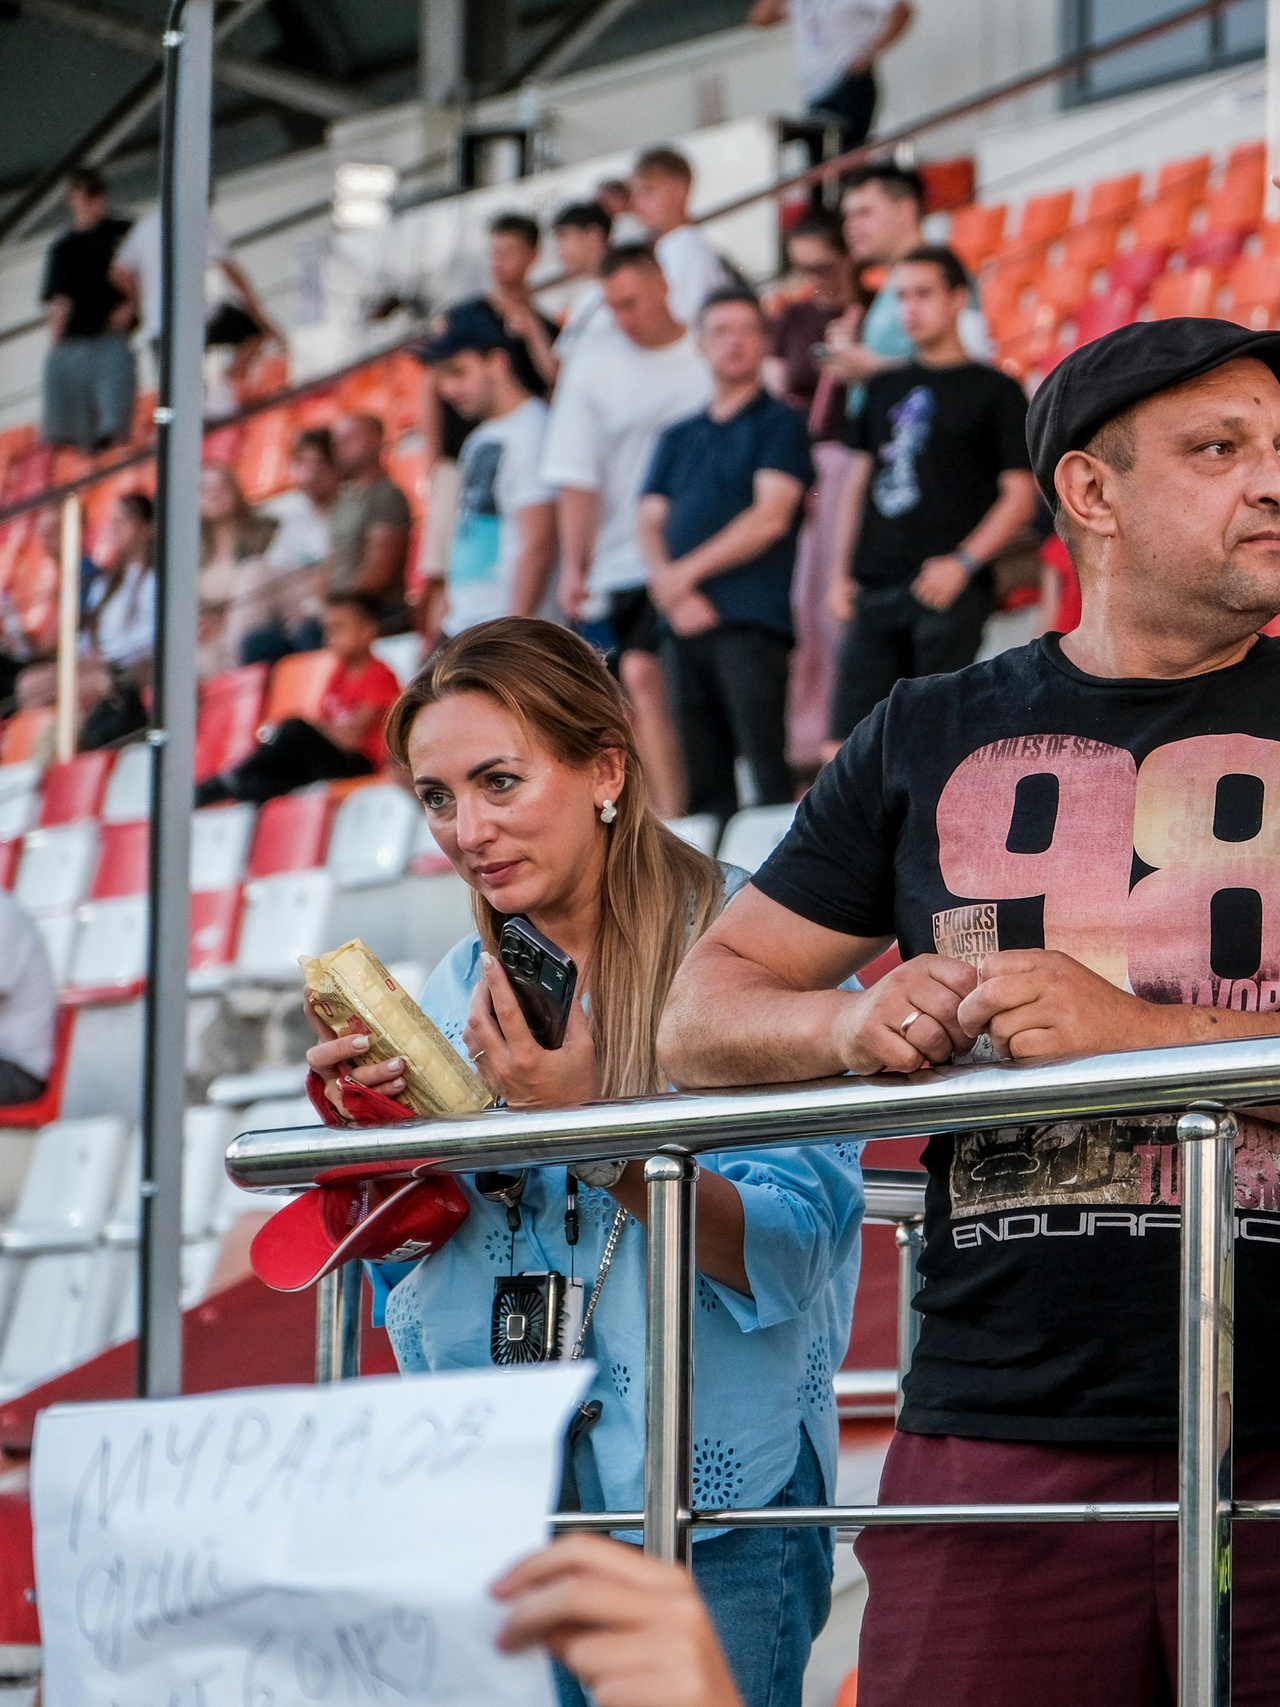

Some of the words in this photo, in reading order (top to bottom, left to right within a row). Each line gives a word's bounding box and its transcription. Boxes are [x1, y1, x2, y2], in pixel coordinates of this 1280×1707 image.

[933, 914, 941, 939] 6
[943, 905, 995, 936] HOURS
[951, 930, 998, 957] AUSTIN
